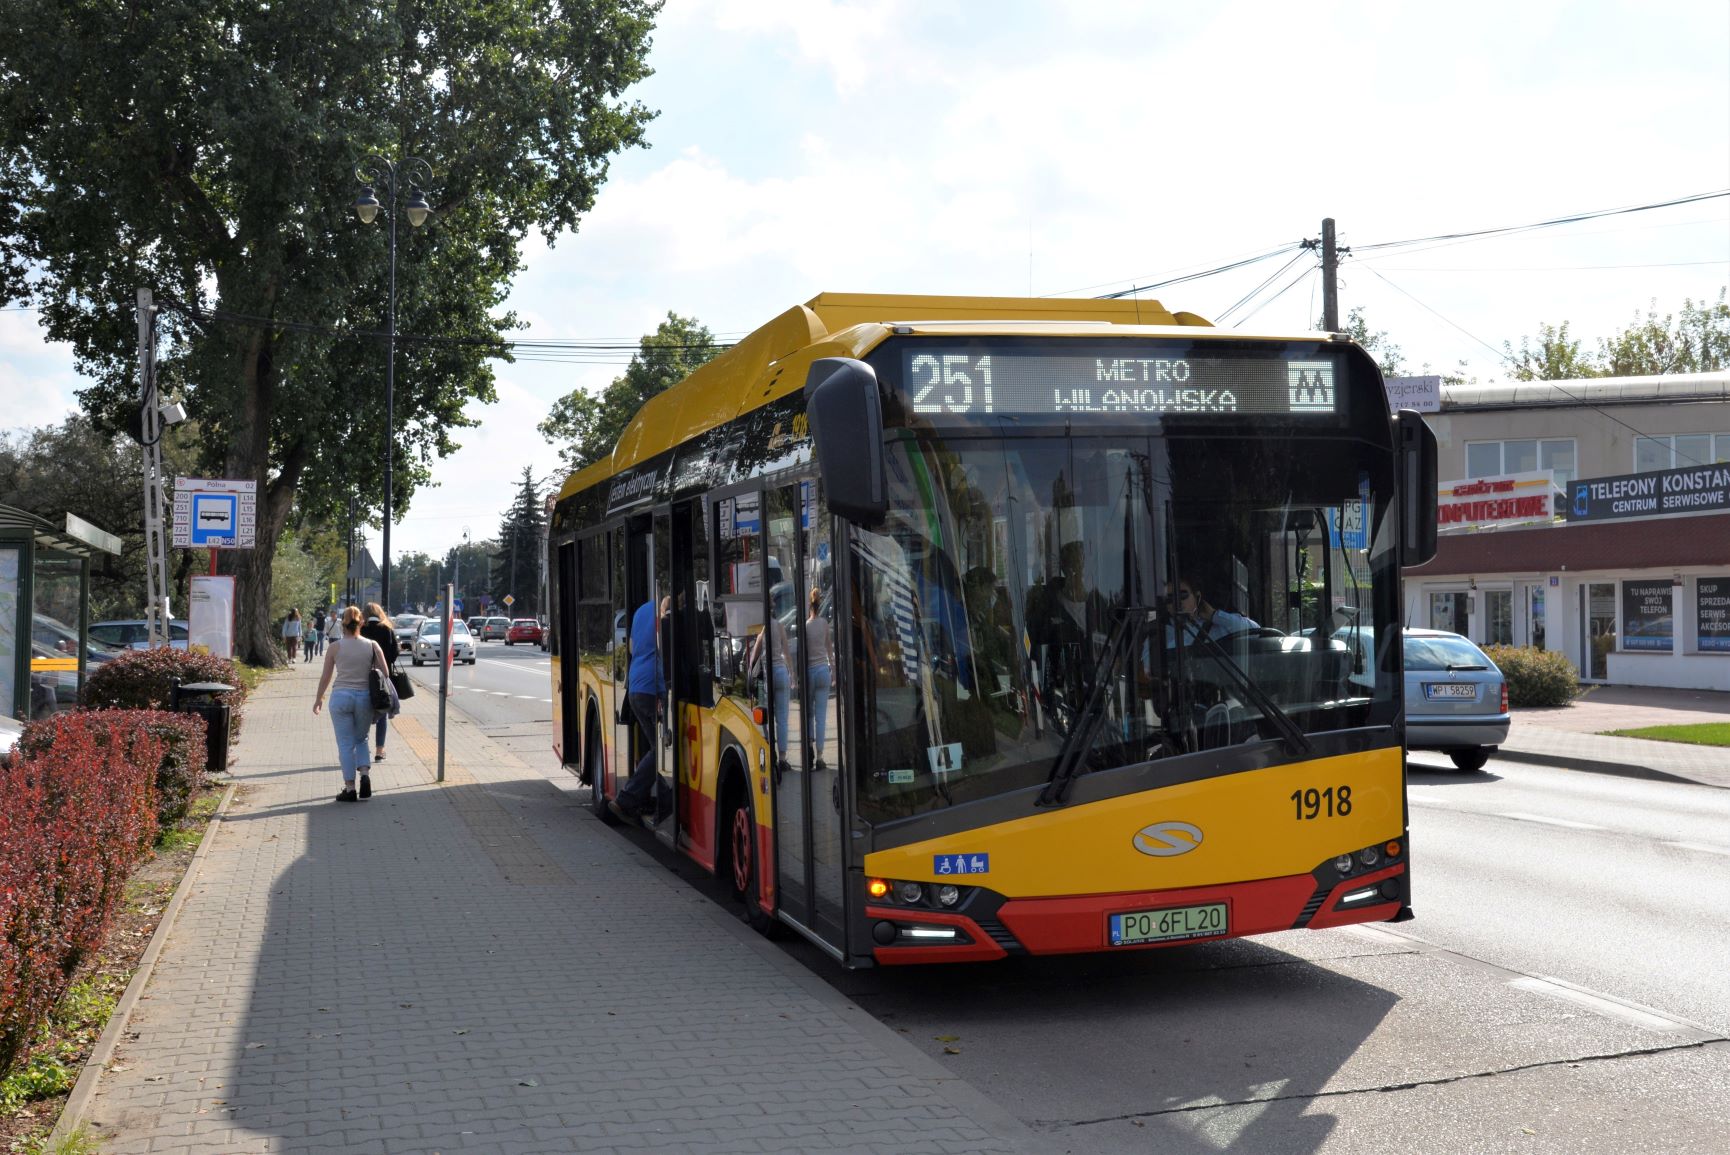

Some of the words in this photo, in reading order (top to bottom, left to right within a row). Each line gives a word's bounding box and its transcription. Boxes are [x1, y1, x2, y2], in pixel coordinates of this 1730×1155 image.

[1096, 359, 1190, 382] METRO
[911, 355, 992, 413] 251
[1386, 381, 1433, 397] yzjerski
[1055, 389, 1237, 412] WILANOWSKA
[1590, 477, 1657, 500] TELEFONY
[1437, 495, 1549, 524] OMPUTEROWE
[1612, 498, 1657, 513] CENTRUM
[1663, 490, 1724, 508] SERWISOWE
[1630, 588, 1639, 596] TU
[1700, 585, 1718, 594] SKUP
[1640, 605, 1668, 614] TELEFON
[1700, 609, 1726, 618] SERWIS
[1450, 685, 1474, 696] 58259
[1290, 785, 1353, 821] 1918
[1125, 915, 1151, 937] PO
[1159, 908, 1221, 933] 6FL20
